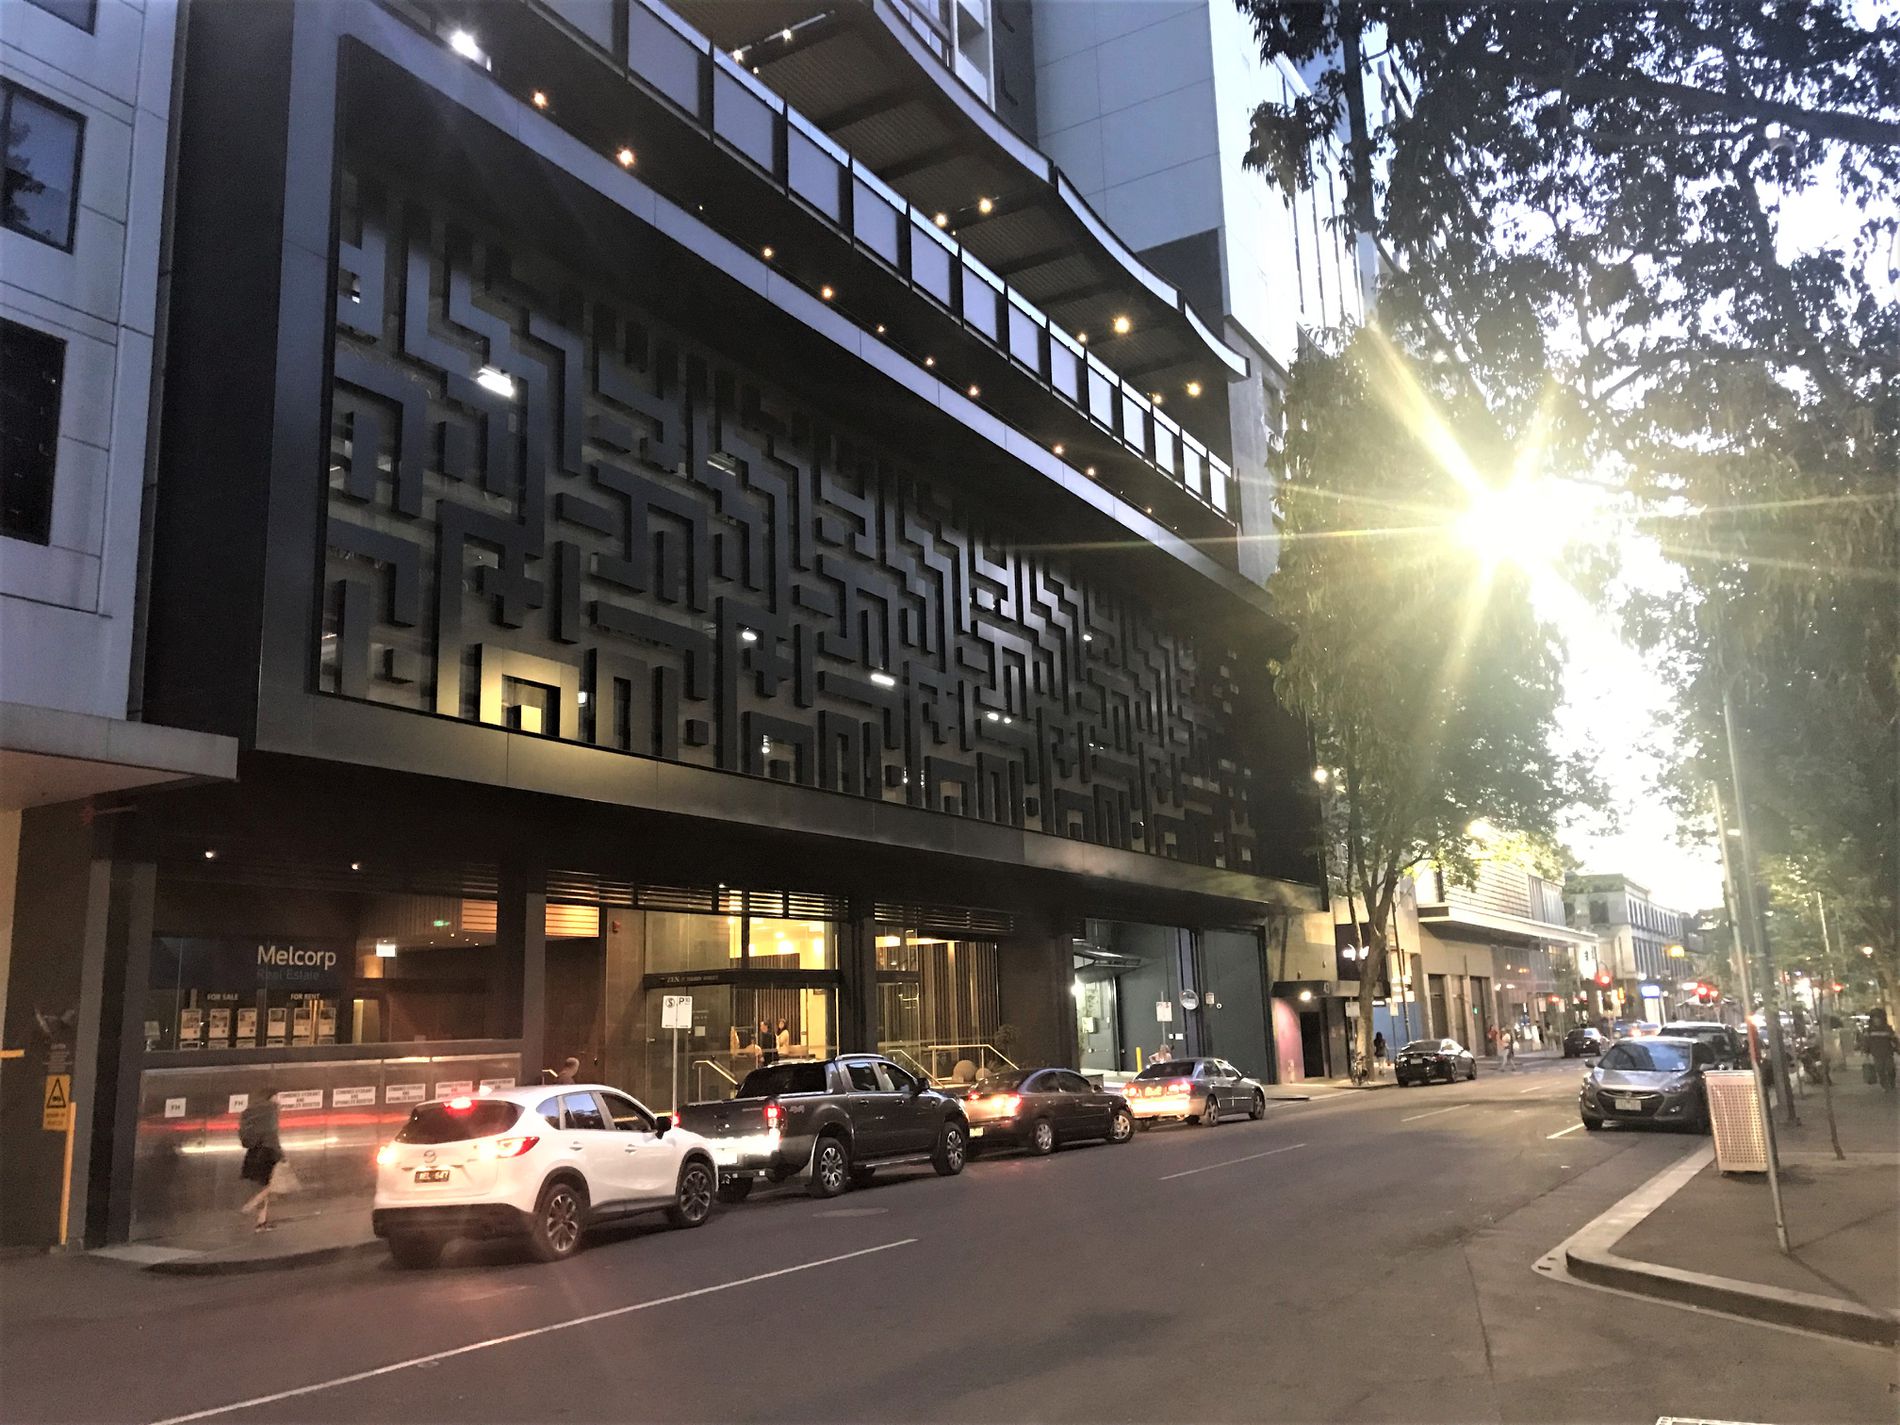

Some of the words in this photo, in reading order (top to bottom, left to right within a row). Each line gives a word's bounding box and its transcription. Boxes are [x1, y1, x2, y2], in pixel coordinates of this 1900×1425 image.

[257, 945, 337, 971] Melcorp
[207, 993, 220, 1001] FOR
[222, 993, 239, 1001] SALE
[290, 993, 303, 1001] FOR
[679, 997, 685, 1006] P
